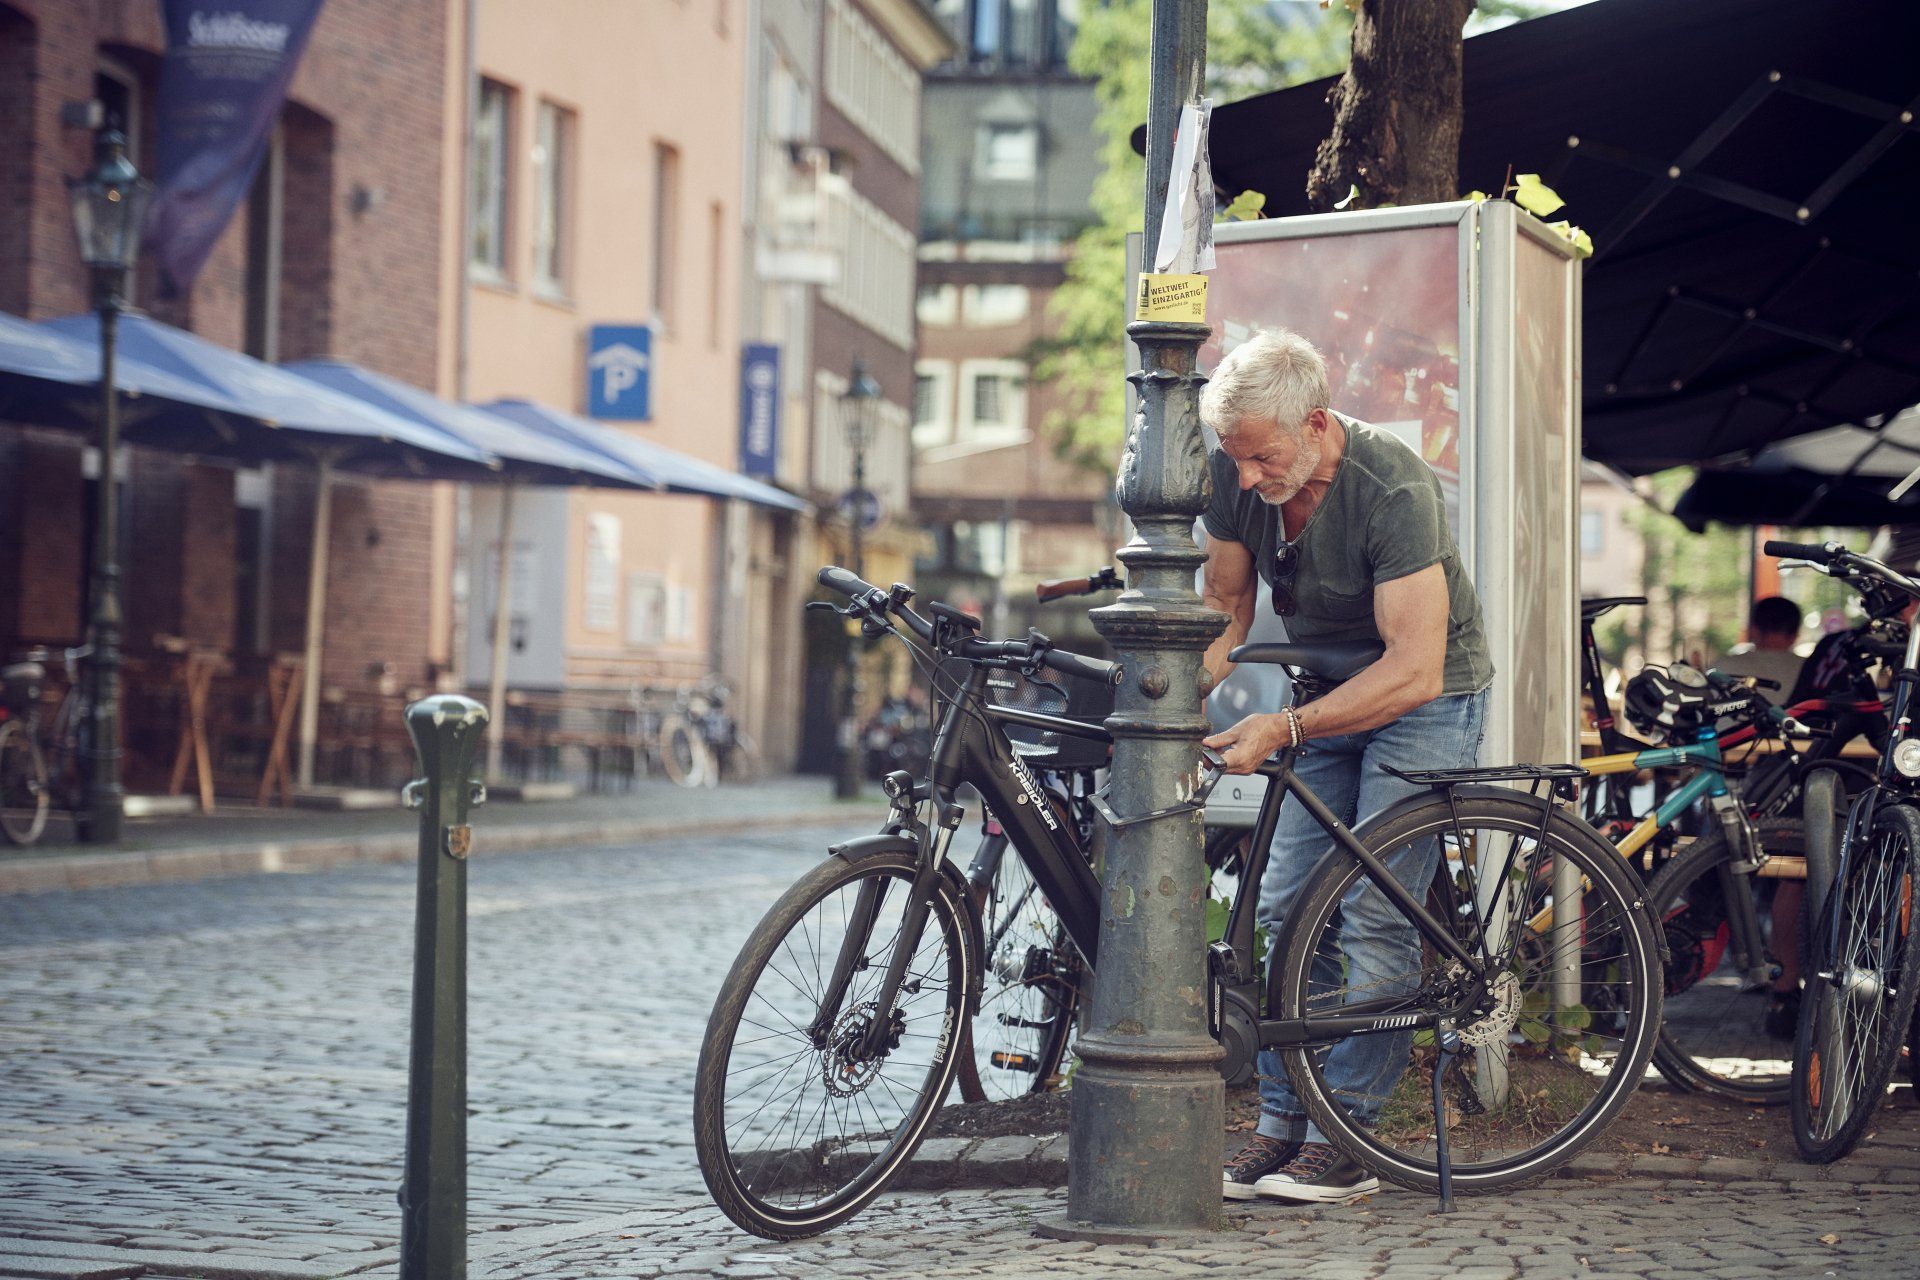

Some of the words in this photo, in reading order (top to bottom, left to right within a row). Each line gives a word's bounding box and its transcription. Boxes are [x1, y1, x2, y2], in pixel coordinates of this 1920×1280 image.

[1151, 282, 1189, 295] WELTWEIT
[1153, 288, 1203, 304] EINZIGARTIG!
[603, 366, 639, 404] P
[1713, 699, 1748, 716] syncros
[1008, 761, 1058, 831] KREIDLER
